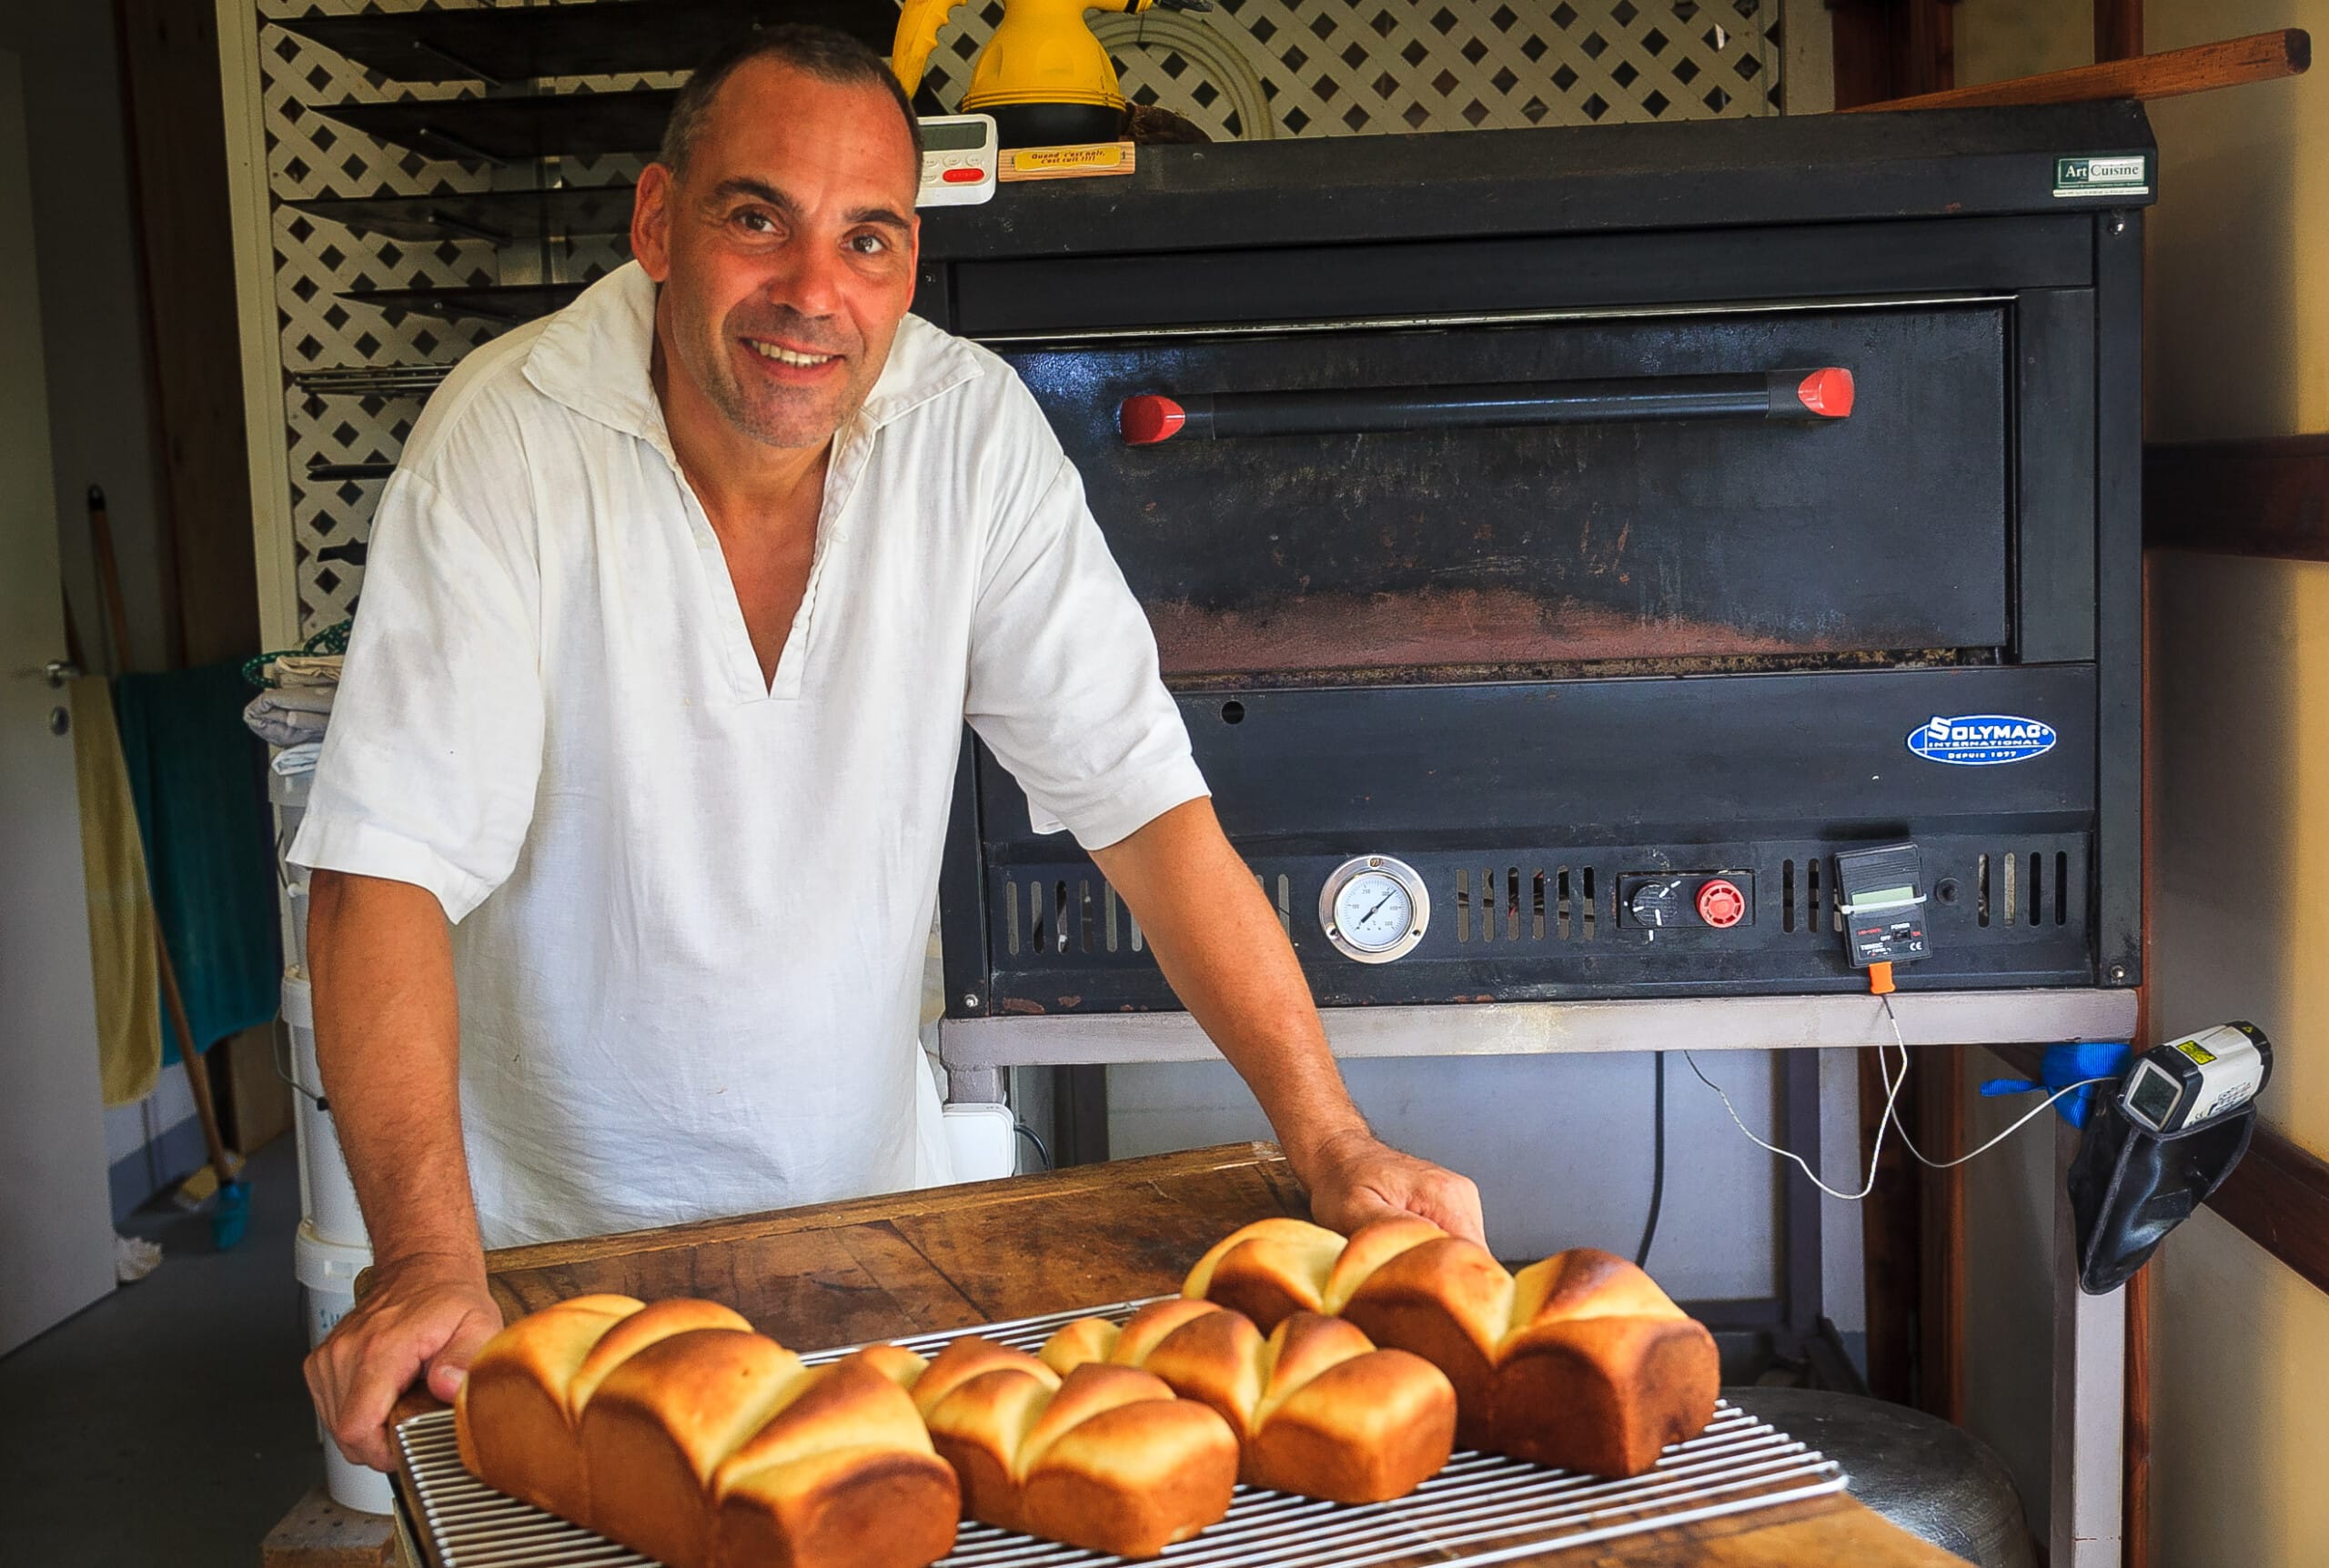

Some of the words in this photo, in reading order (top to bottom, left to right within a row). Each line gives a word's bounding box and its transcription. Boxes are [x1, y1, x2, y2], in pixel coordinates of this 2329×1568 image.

[2065, 165, 2088, 177] Art
[2091, 163, 2139, 176] Cuisine
[1928, 739, 2041, 748] INTERNATIONAL
